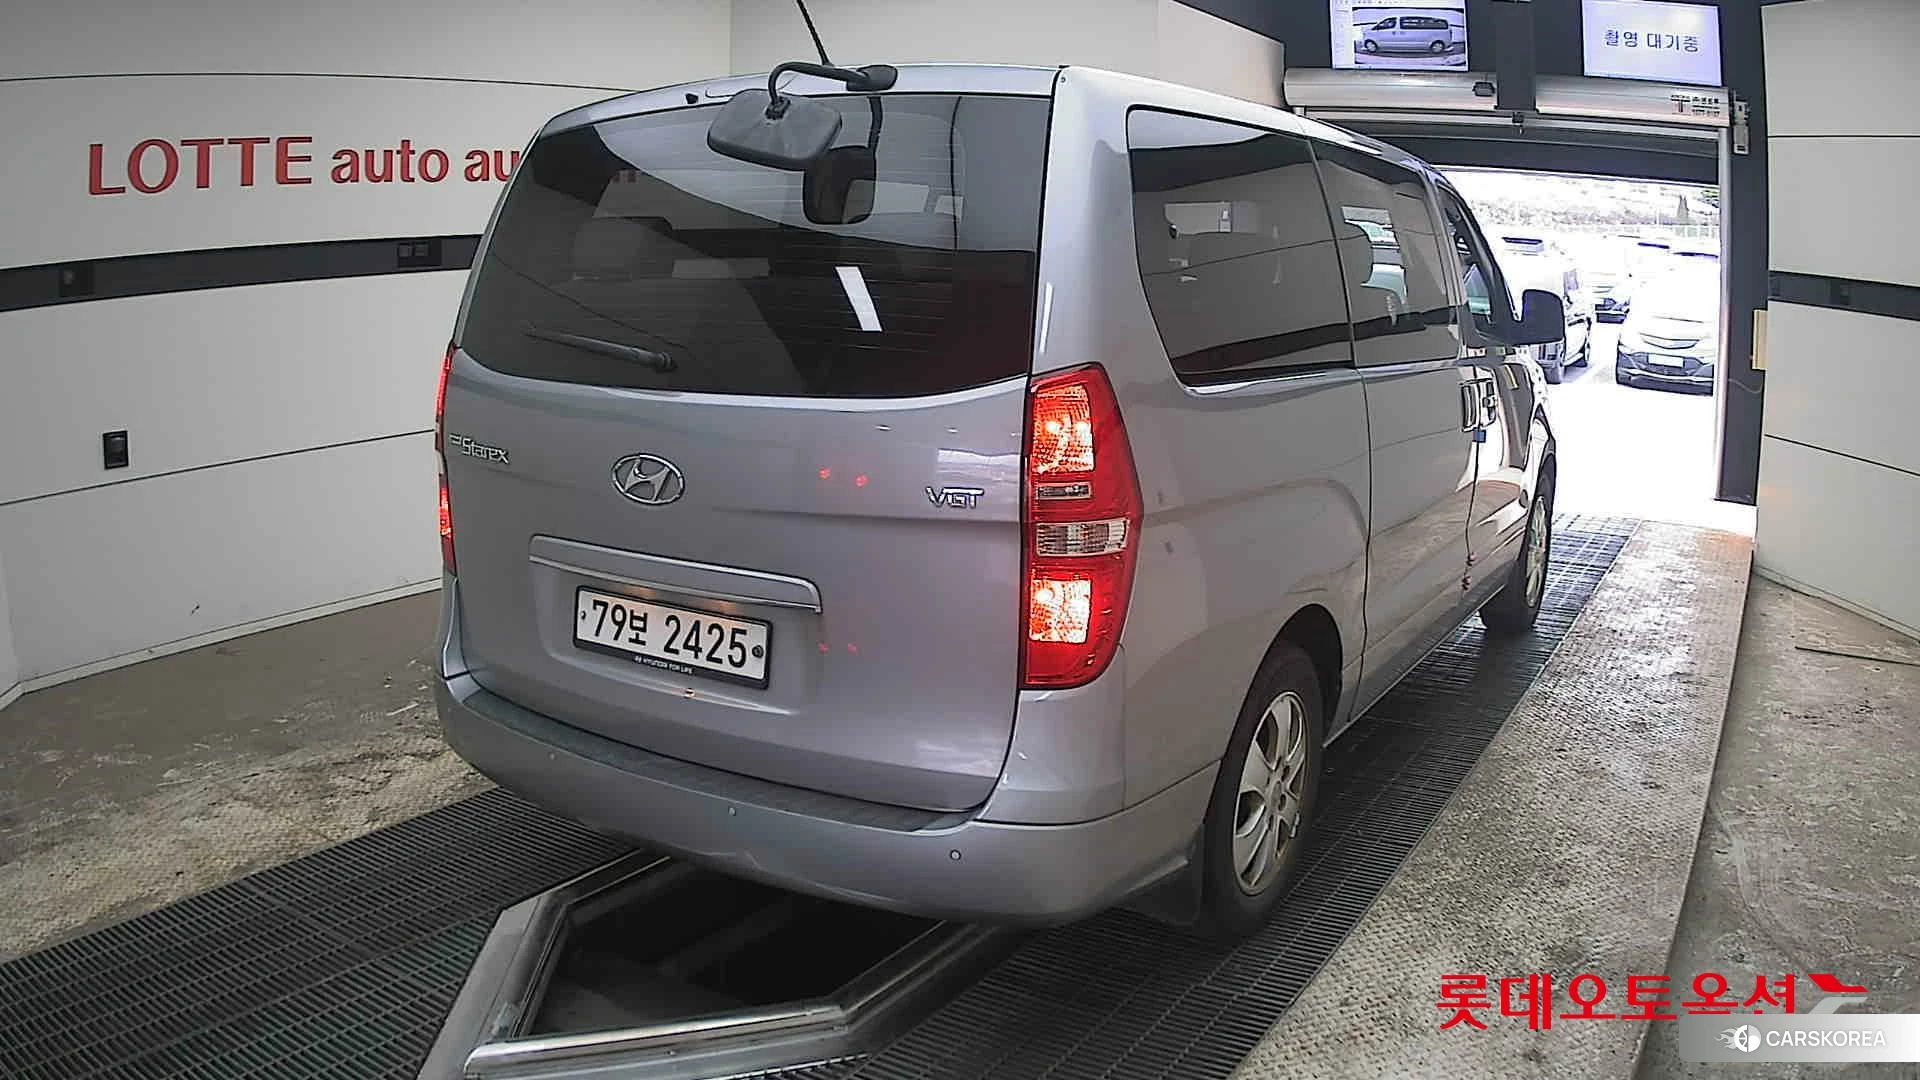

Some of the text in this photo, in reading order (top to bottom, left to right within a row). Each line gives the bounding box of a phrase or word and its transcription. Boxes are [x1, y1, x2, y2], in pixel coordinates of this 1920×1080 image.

[1604, 28, 1699, 53] 촬영 대기중
[88, 136, 520, 196] LOTTE auto au
[925, 486, 984, 509] VGT
[592, 600, 748, 668] 79보 2425
